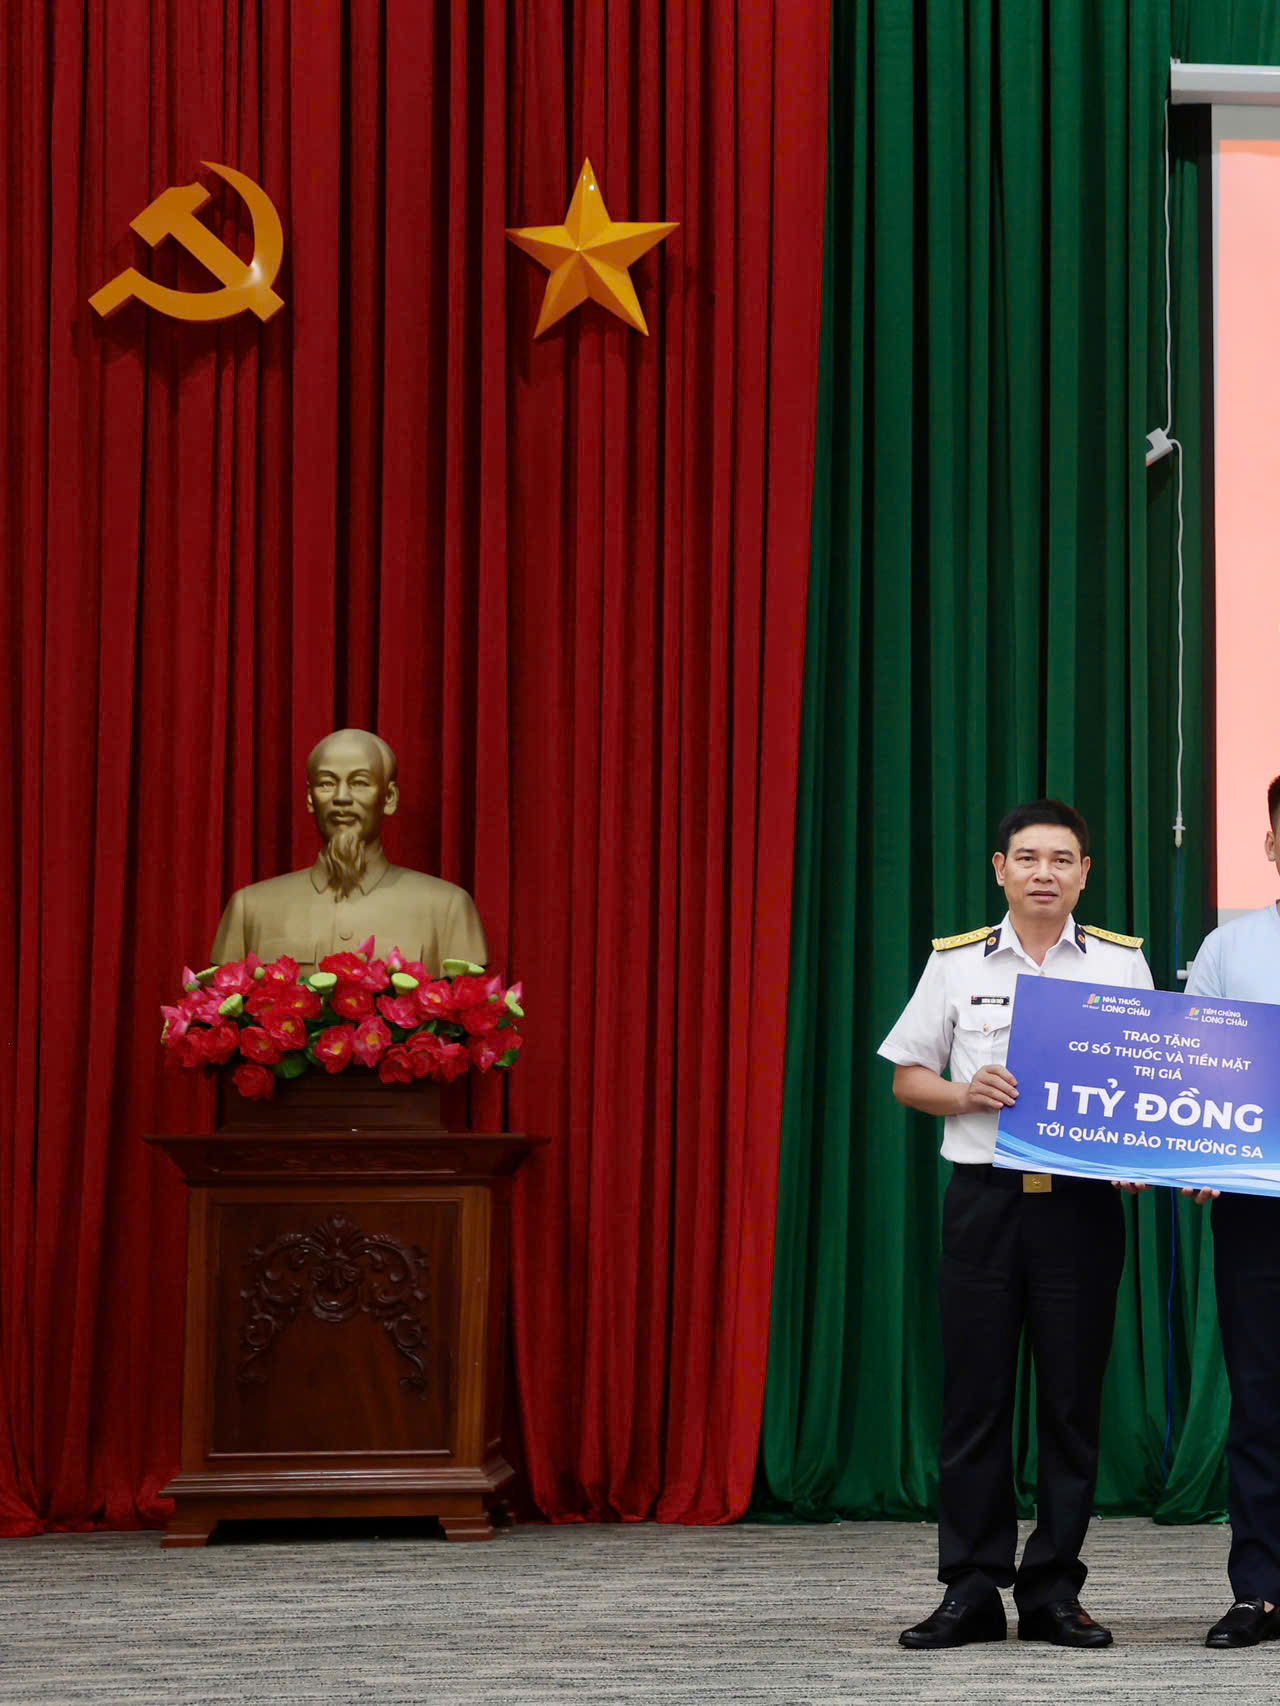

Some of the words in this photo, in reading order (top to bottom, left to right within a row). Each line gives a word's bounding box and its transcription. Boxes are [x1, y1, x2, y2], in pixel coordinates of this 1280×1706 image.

[1102, 995, 1117, 1004] NHÀ
[1101, 1004, 1126, 1014] LONG
[1127, 1006, 1150, 1017] CHÂU
[1201, 1015, 1224, 1025] LONG
[1225, 1016, 1248, 1027] CHÂU
[1122, 1030, 1160, 1044] TRAO
[1164, 1034, 1201, 1049] TẶNG
[1069, 1041, 1089, 1052] CƠ
[1091, 1042, 1112, 1055] SỐ
[1114, 1046, 1163, 1061] THUỐC
[1166, 1051, 1184, 1064] VÀ
[1221, 1057, 1251, 1072] MẶT
[1133, 1065, 1155, 1080] TRỊ
[1159, 1068, 1182, 1081] GIÁ
[1044, 1081, 1060, 1111] 1
[1072, 1078, 1126, 1118] TỶ
[1134, 1087, 1264, 1133] ĐỒNG
[1036, 1121, 1064, 1138] TỚI
[1123, 1131, 1161, 1149] ĐẢO
[1165, 1136, 1237, 1157] TRƯỜNG
[1241, 1145, 1264, 1159] SA
